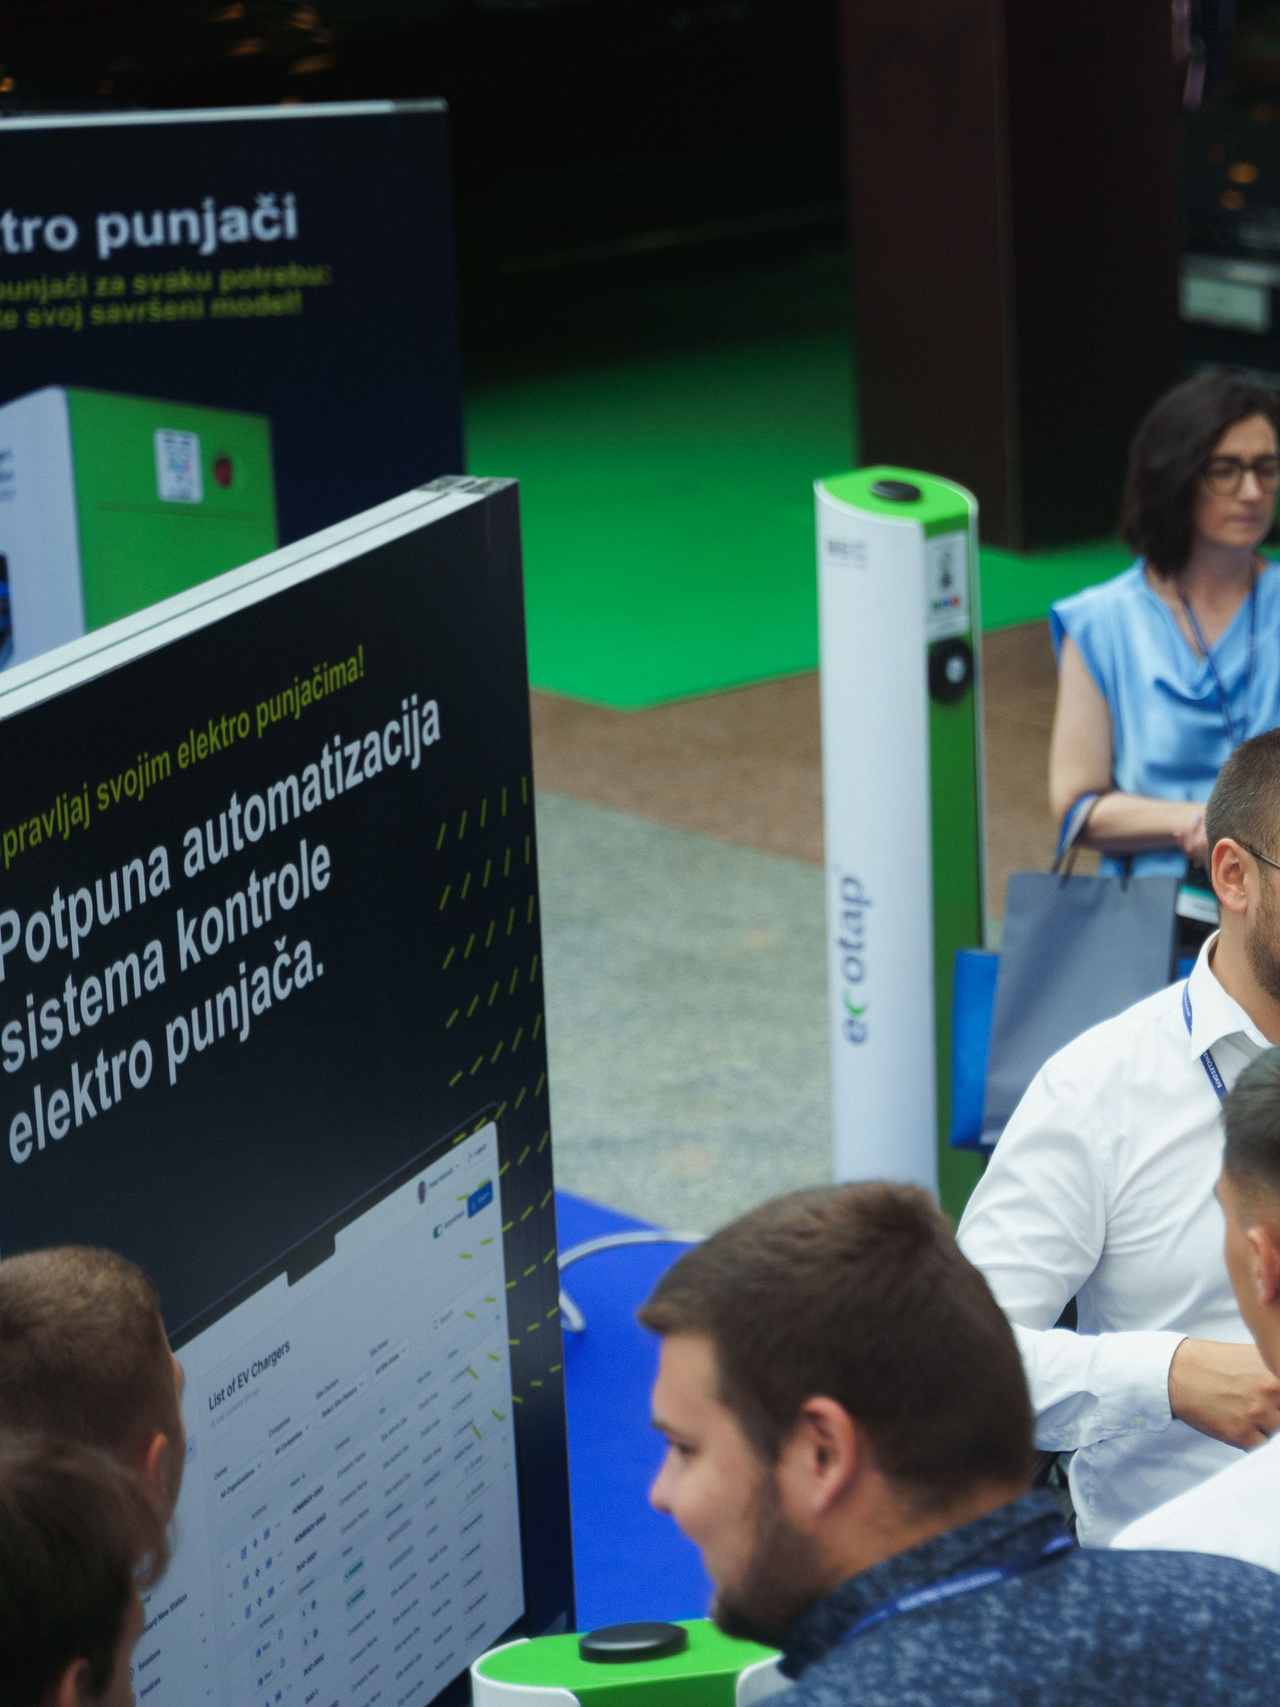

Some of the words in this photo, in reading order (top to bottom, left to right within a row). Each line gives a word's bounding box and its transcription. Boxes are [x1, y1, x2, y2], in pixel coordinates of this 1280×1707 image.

[94, 275, 127, 298] za
[131, 266, 213, 296] svaku
[96, 192, 299, 261] punjači
[0, 844, 170, 982] Potpuna
[182, 693, 441, 878] automatizacija
[2, 782, 90, 869] pravljaj
[97, 749, 171, 813] svojim
[177, 711, 250, 771] elektro
[256, 644, 365, 741] punjačima!
[0, 938, 166, 1073] sistema
[176, 838, 332, 972] kontrole
[9, 1037, 153, 1164] elektro
[166, 935, 325, 1086] punjača.
[837, 875, 873, 1046] ecotap
[208, 1387, 226, 1412] List
[226, 1376, 236, 1397] of
[237, 1367, 250, 1389] EV
[250, 1340, 291, 1379] Chargers
